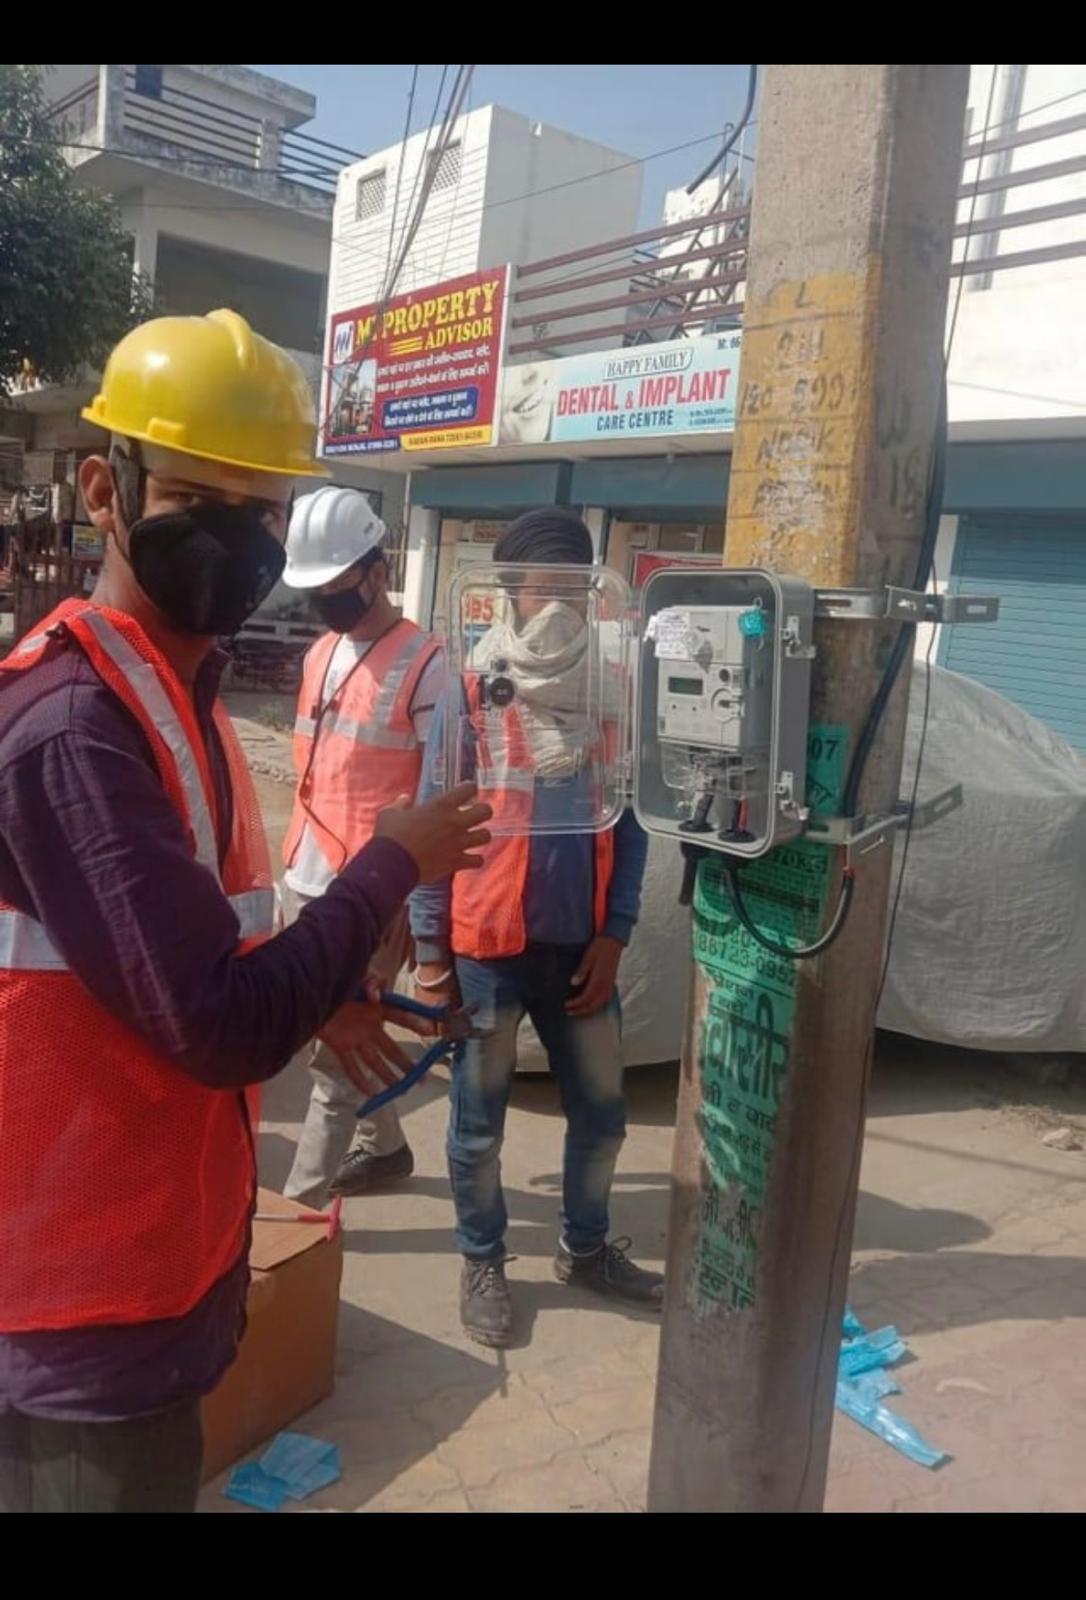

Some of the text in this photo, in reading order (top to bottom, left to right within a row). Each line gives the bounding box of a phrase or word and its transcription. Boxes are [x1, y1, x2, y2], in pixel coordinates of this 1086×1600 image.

[381, 280, 500, 339] PROPERTY
[424, 317, 493, 350] ADVISOR
[607, 351, 688, 377] HAPPY FAMILY
[557, 368, 731, 416] DENTAL & IMPLANT
[597, 413, 624, 431] CARE
[629, 410, 673, 428] CENTRE
